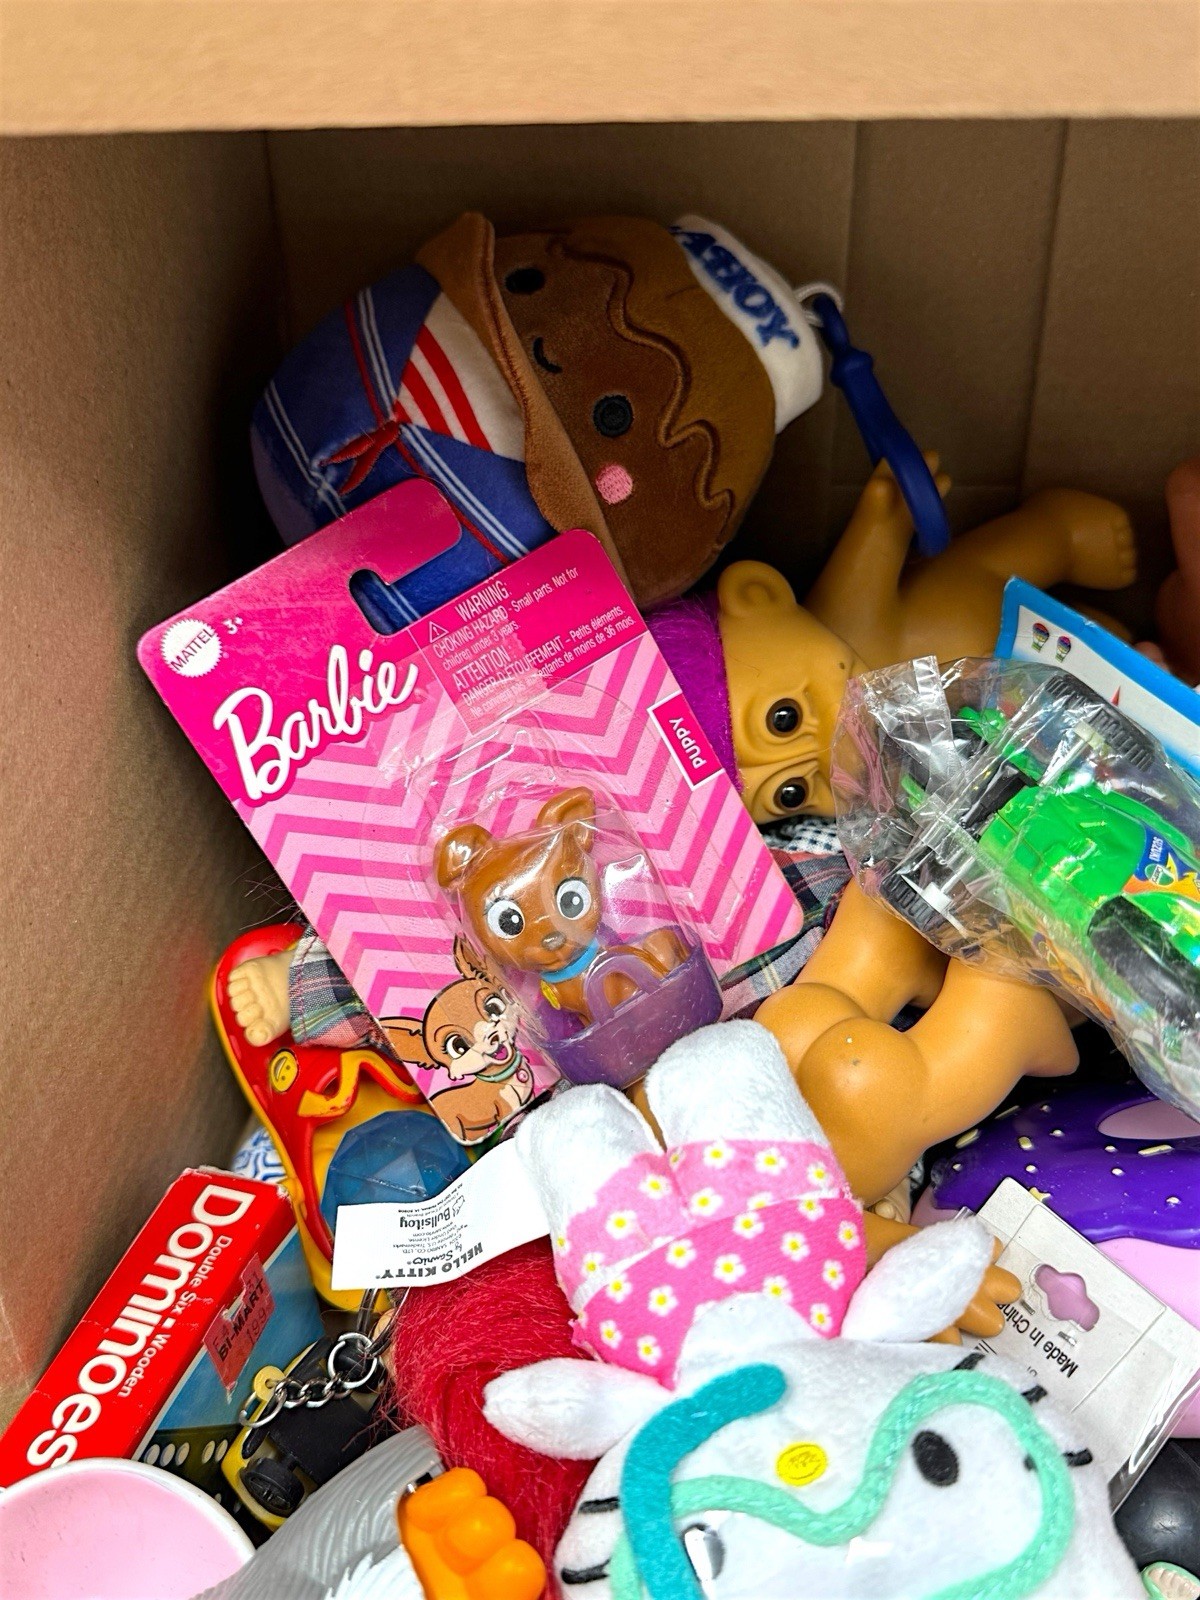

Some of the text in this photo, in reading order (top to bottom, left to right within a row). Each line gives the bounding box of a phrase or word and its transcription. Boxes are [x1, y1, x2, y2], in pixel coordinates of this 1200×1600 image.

[433, 626, 474, 658] CHOKING
[471, 605, 509, 636] HAZARD
[511, 592, 535, 613] Small
[552, 571, 567, 588] Not
[566, 567, 579, 580] for
[455, 580, 513, 622] WARNING:
[170, 627, 215, 671] MATTEL
[443, 648, 472, 671] children
[471, 636, 492, 654] under
[491, 629, 499, 641] 3
[564, 651, 574, 663] de
[573, 638, 597, 657] moins
[595, 632, 606, 645] de
[604, 624, 616, 638] 36
[569, 624, 592, 642] Petits
[452, 645, 511, 692] ATTENTION
[213, 645, 418, 800] Barbie
[668, 717, 707, 769] PUPPY
[400, 1207, 450, 1230] Bullsitoy
[441, 1241, 483, 1273] HELLO
[454, 1241, 462, 1252] by
[26, 1184, 256, 1468] Dominoes
[117, 1235, 233, 1398] Double Six Wooden
[218, 1278, 264, 1361] BI-MART
[1029, 1327, 1045, 1347] In
[1042, 1340, 1079, 1378] Made
